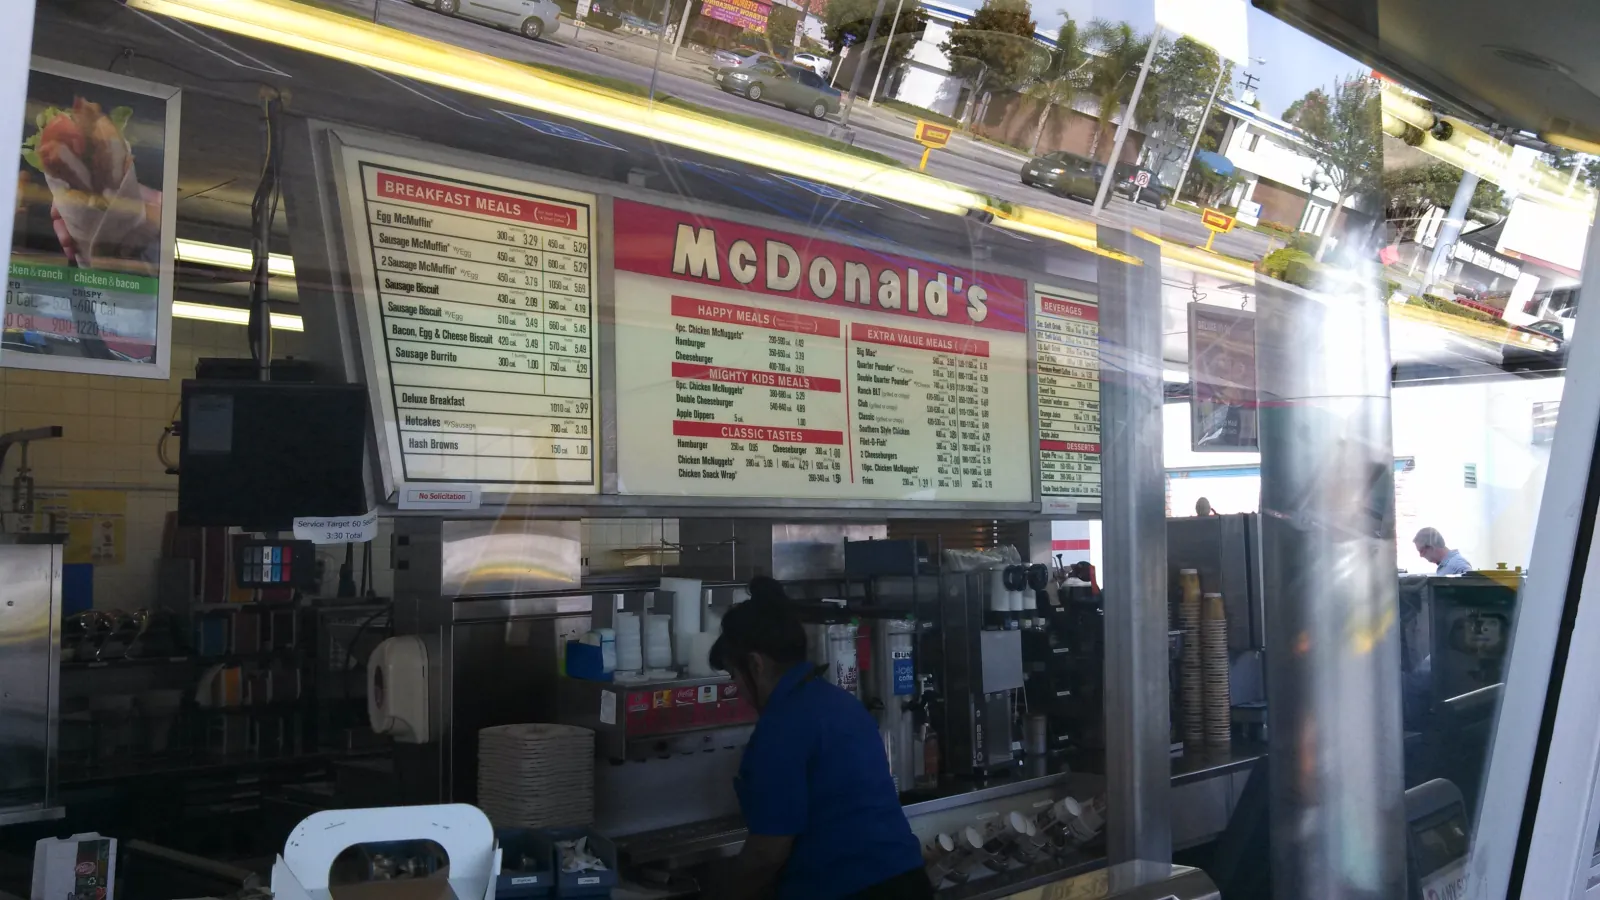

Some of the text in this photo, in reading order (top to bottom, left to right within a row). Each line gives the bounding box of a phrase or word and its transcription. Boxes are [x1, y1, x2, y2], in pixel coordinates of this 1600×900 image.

[385, 180, 521, 216] BREAKFAST MEALS
[377, 210, 391, 224] Egg
[497, 230, 508, 241] 300
[523, 233, 538, 247] 3.29
[573, 241, 587, 254] 5.29
[379, 233, 410, 247] Sausage
[497, 251, 508, 262] 450
[574, 261, 587, 273] 5.29
[8, 264, 29, 276] cken
[38, 268, 63, 280] ranch
[381, 256, 387, 266] 2
[388, 256, 417, 271] Sausage
[497, 272, 508, 283] 450
[672, 223, 988, 323] McDonald's
[74, 273, 108, 286] chicken
[115, 276, 140, 290] bacon
[385, 278, 415, 293] Sausage
[416, 282, 440, 295] Biscuit
[698, 305, 770, 324] HAPPY MEALS
[1044, 301, 1082, 316] BEVERAGES
[388, 301, 418, 316] Sausage
[419, 304, 442, 317] Biscuit
[498, 315, 509, 325] 510
[574, 323, 586, 334] 5.49
[688, 324, 711, 336] Chicken
[392, 324, 417, 338] Bacon,
[419, 327, 433, 340] Egg
[434, 328, 441, 339] &
[442, 329, 468, 342] Cheese
[469, 332, 493, 344] Biscuit
[525, 338, 539, 349] 3.49
[574, 344, 587, 354] 5.49
[675, 336, 706, 349] Hamburger
[867, 329, 896, 342] EXTRA
[897, 333, 924, 346] VALUE
[926, 337, 953, 349] MEALS
[395, 347, 429, 361] Sausage
[431, 350, 457, 362] Burrito
[527, 359, 539, 370] 1.00
[675, 350, 713, 365] Cheeseburger
[709, 368, 810, 388] MIGHTY KIDS MEALS
[689, 381, 711, 392] Chicken
[402, 392, 428, 404] Deluxe
[430, 394, 466, 406] Breakfast
[676, 393, 734, 408] Double Cheeseburger
[405, 415, 441, 427] Hotcakes
[676, 408, 692, 420] Apple
[693, 409, 715, 421] Dippers
[721, 426, 803, 441] CLASSIC TASTES
[409, 438, 588, 455] Hash Browns 150 1.00
[677, 438, 708, 451] Hamburger
[772, 443, 807, 456] Cheeseburger
[1066, 442, 1095, 452] DESSERTS
[677, 454, 701, 465] Chicken
[678, 468, 701, 478] Chicken
[702, 469, 720, 479] Snack
[418, 492, 466, 501] No Solicitation
[298, 520, 325, 528] Service
[326, 520, 350, 529] Target
[352, 519, 361, 527] 60
[326, 531, 363, 540] 3:30 Total
